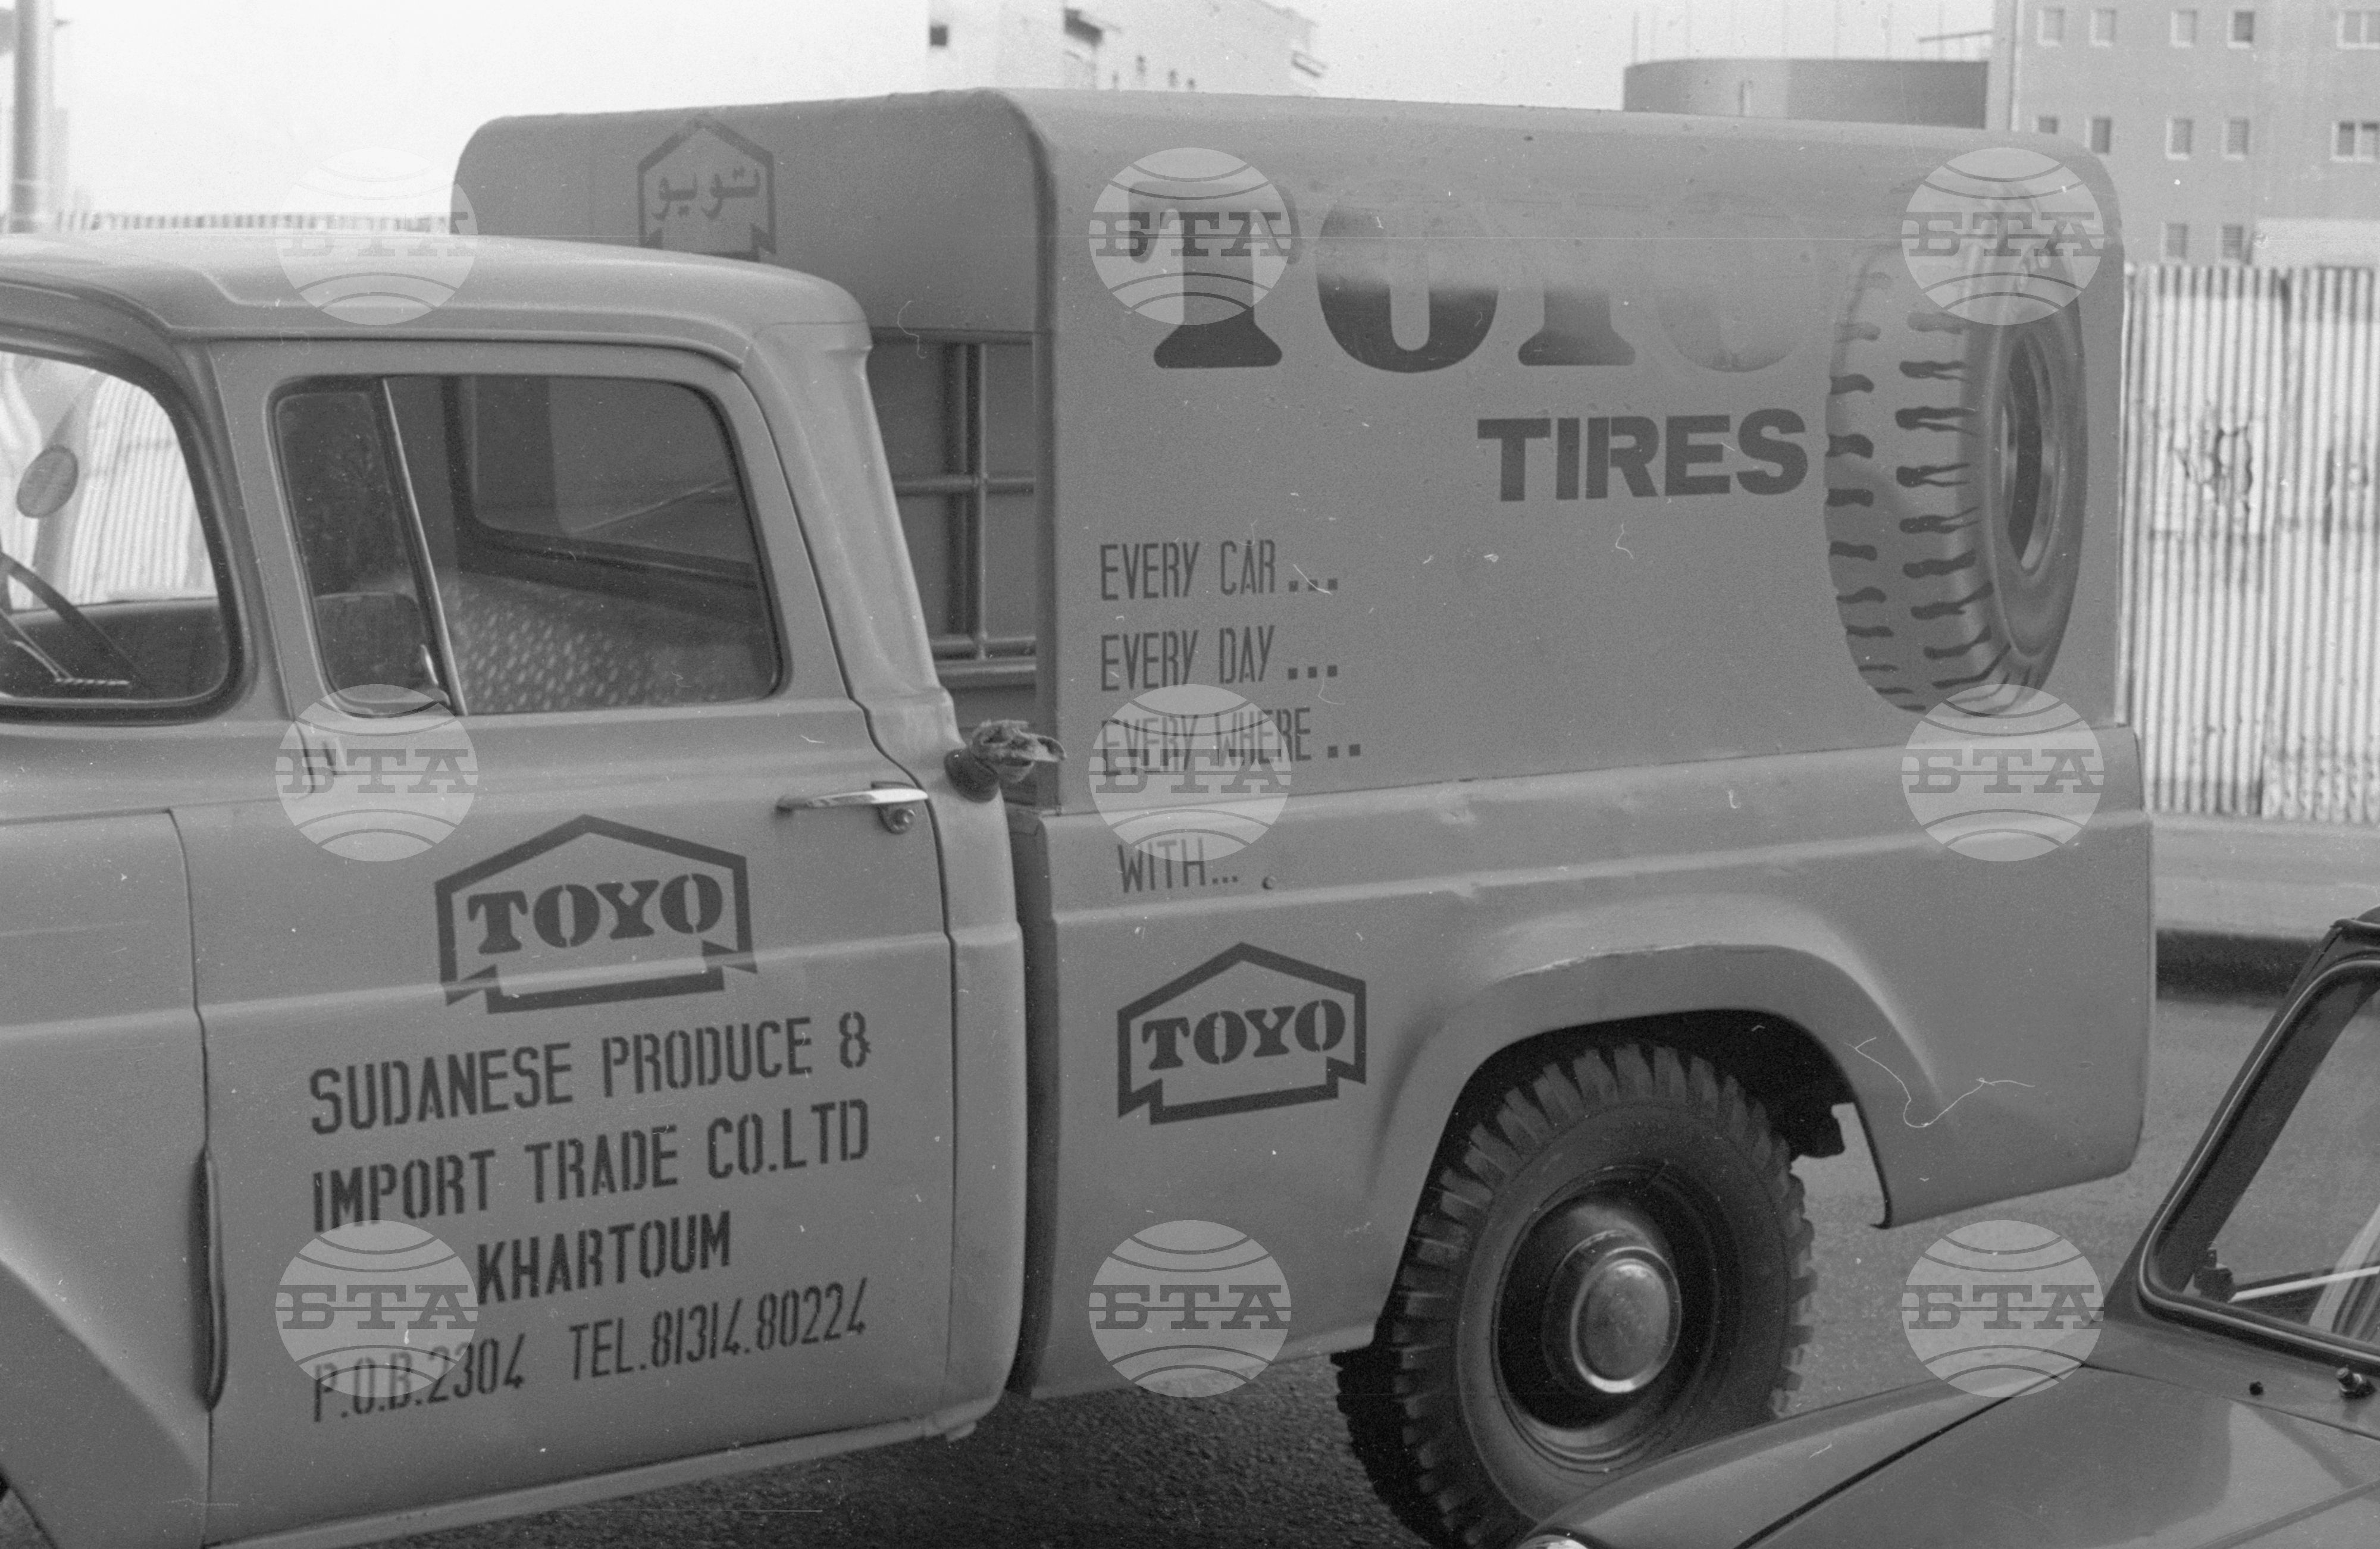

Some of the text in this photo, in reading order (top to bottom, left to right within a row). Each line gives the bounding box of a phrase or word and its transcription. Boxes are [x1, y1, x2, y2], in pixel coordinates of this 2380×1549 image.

[1477, 409, 1808, 503] TIRES
[1100, 541, 1200, 601] EVERY
[1101, 629, 1199, 692] EVERY
[1101, 714, 1198, 776] EVERY
[466, 873, 724, 954] TOYO
[309, 1042, 574, 1135] SUDANESE
[602, 1017, 813, 1098] PRODUCE
[1142, 999, 1346, 1071] TOYO
[312, 1099, 869, 1233] IMPORT TRADE CO.LTD
[477, 1210, 731, 1306] KHARTOUM
[314, 1332, 526, 1423] P.O.B.2304
